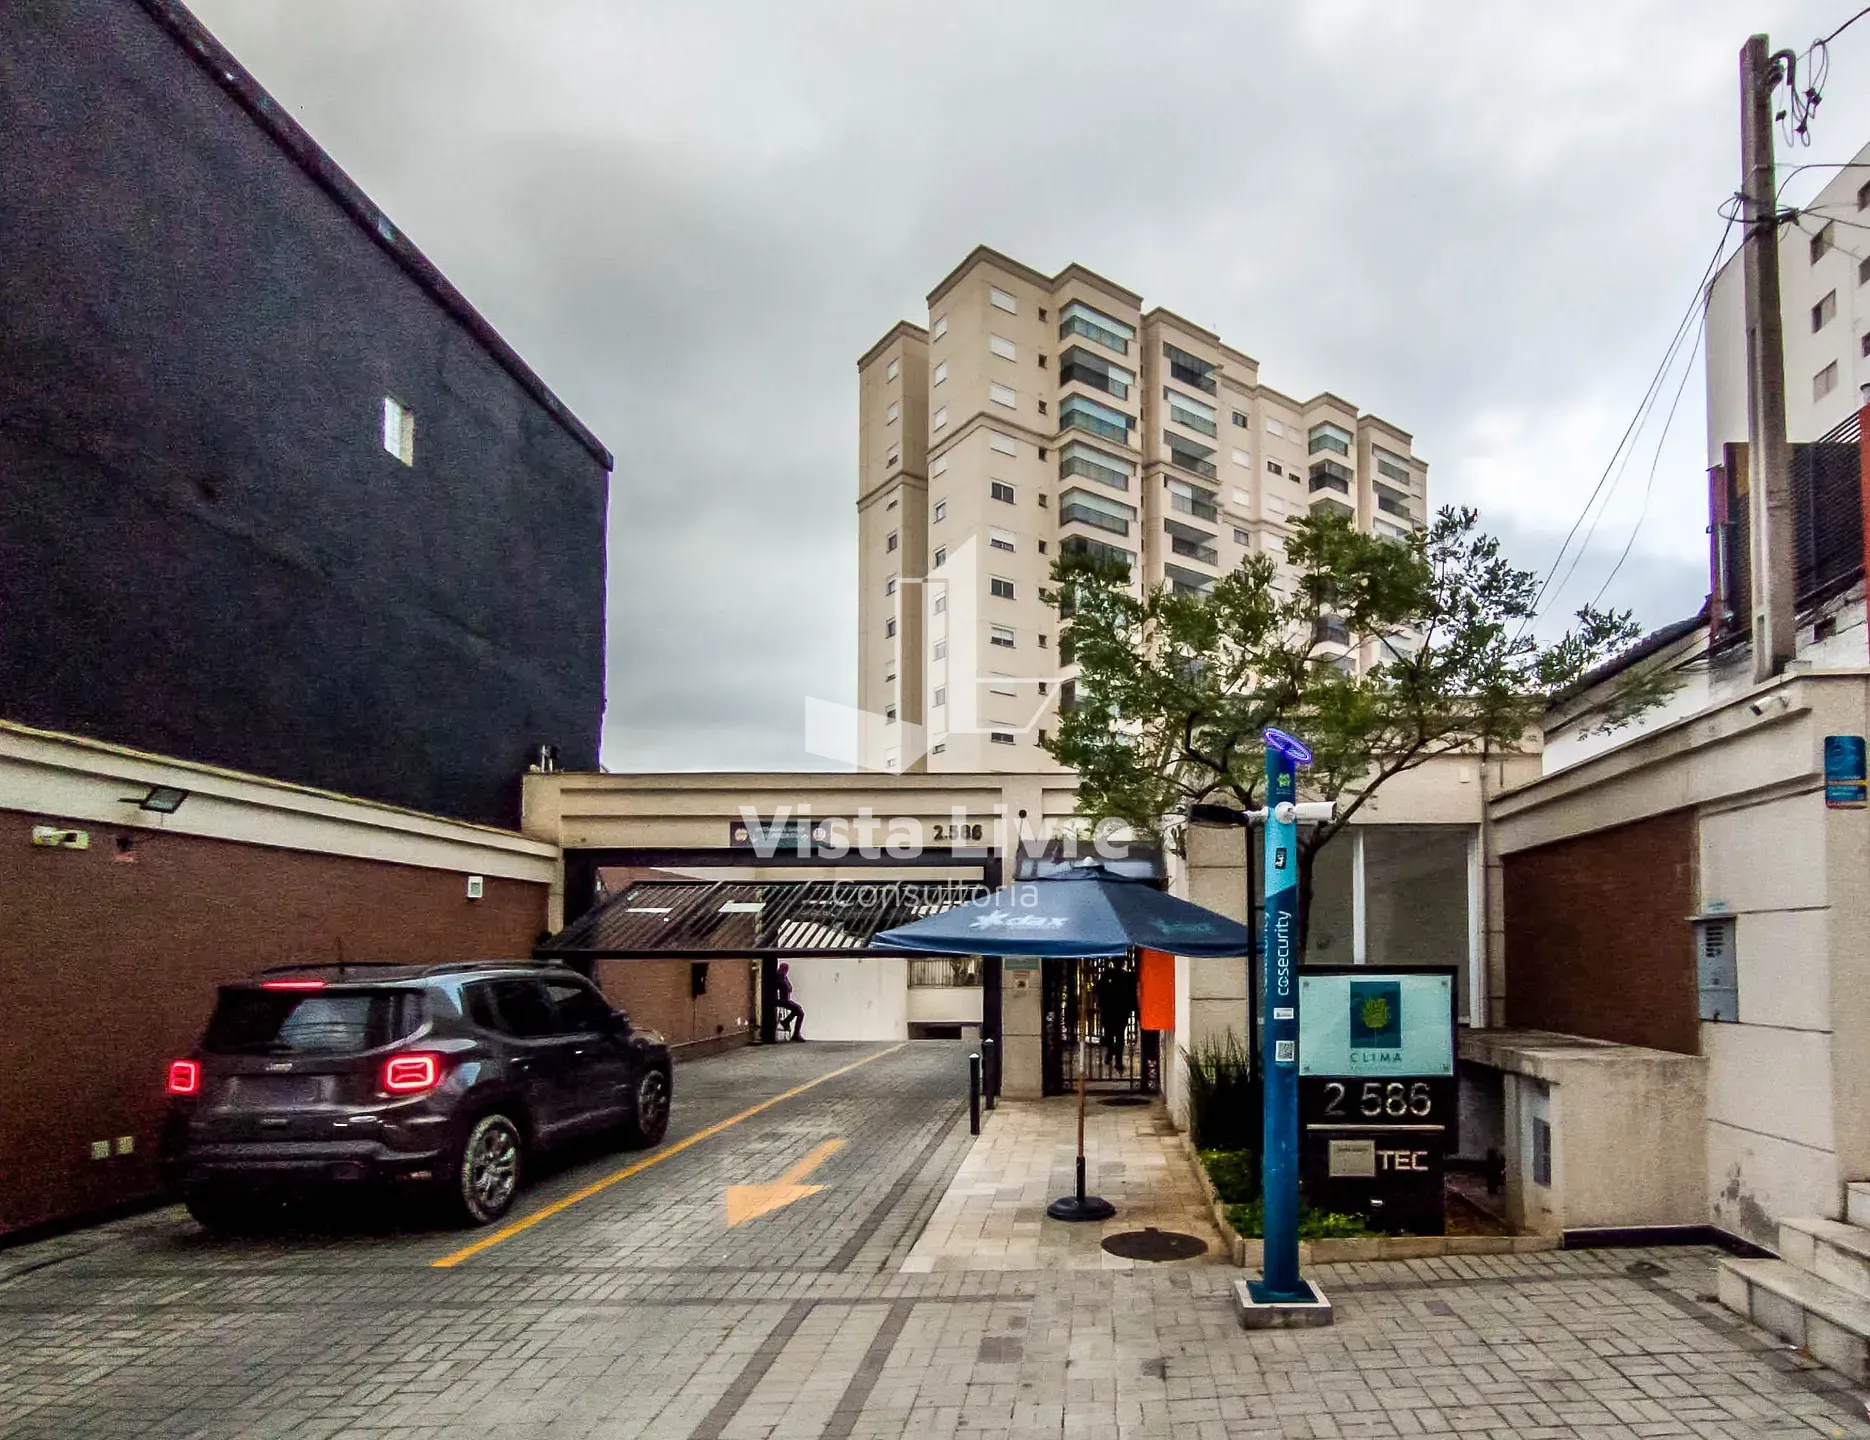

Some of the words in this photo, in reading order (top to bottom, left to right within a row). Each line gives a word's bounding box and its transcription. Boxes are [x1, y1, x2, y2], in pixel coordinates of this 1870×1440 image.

[1274, 911, 1291, 996] cosecurity
[1350, 1052, 1403, 1064] CLIMA
[1376, 1150, 1429, 1170] TEC
